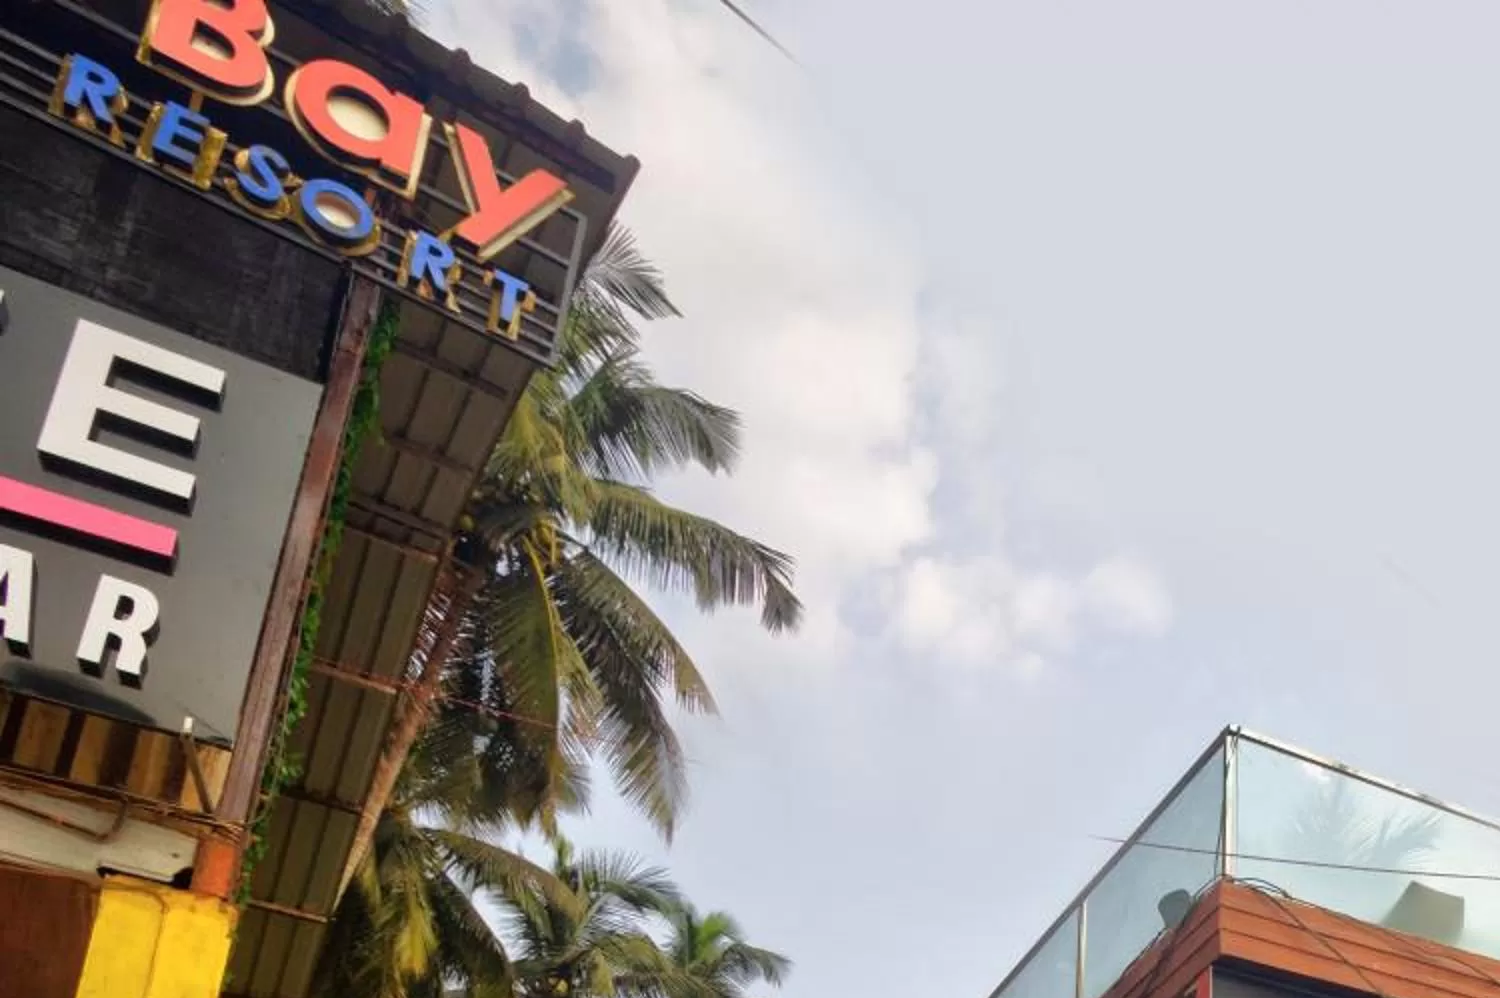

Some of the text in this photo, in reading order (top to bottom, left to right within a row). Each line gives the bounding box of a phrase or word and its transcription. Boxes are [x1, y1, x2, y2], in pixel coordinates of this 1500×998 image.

[52, 53, 536, 338] RESORT
[139, 0, 573, 258] Bay
[0, 290, 226, 500] E
